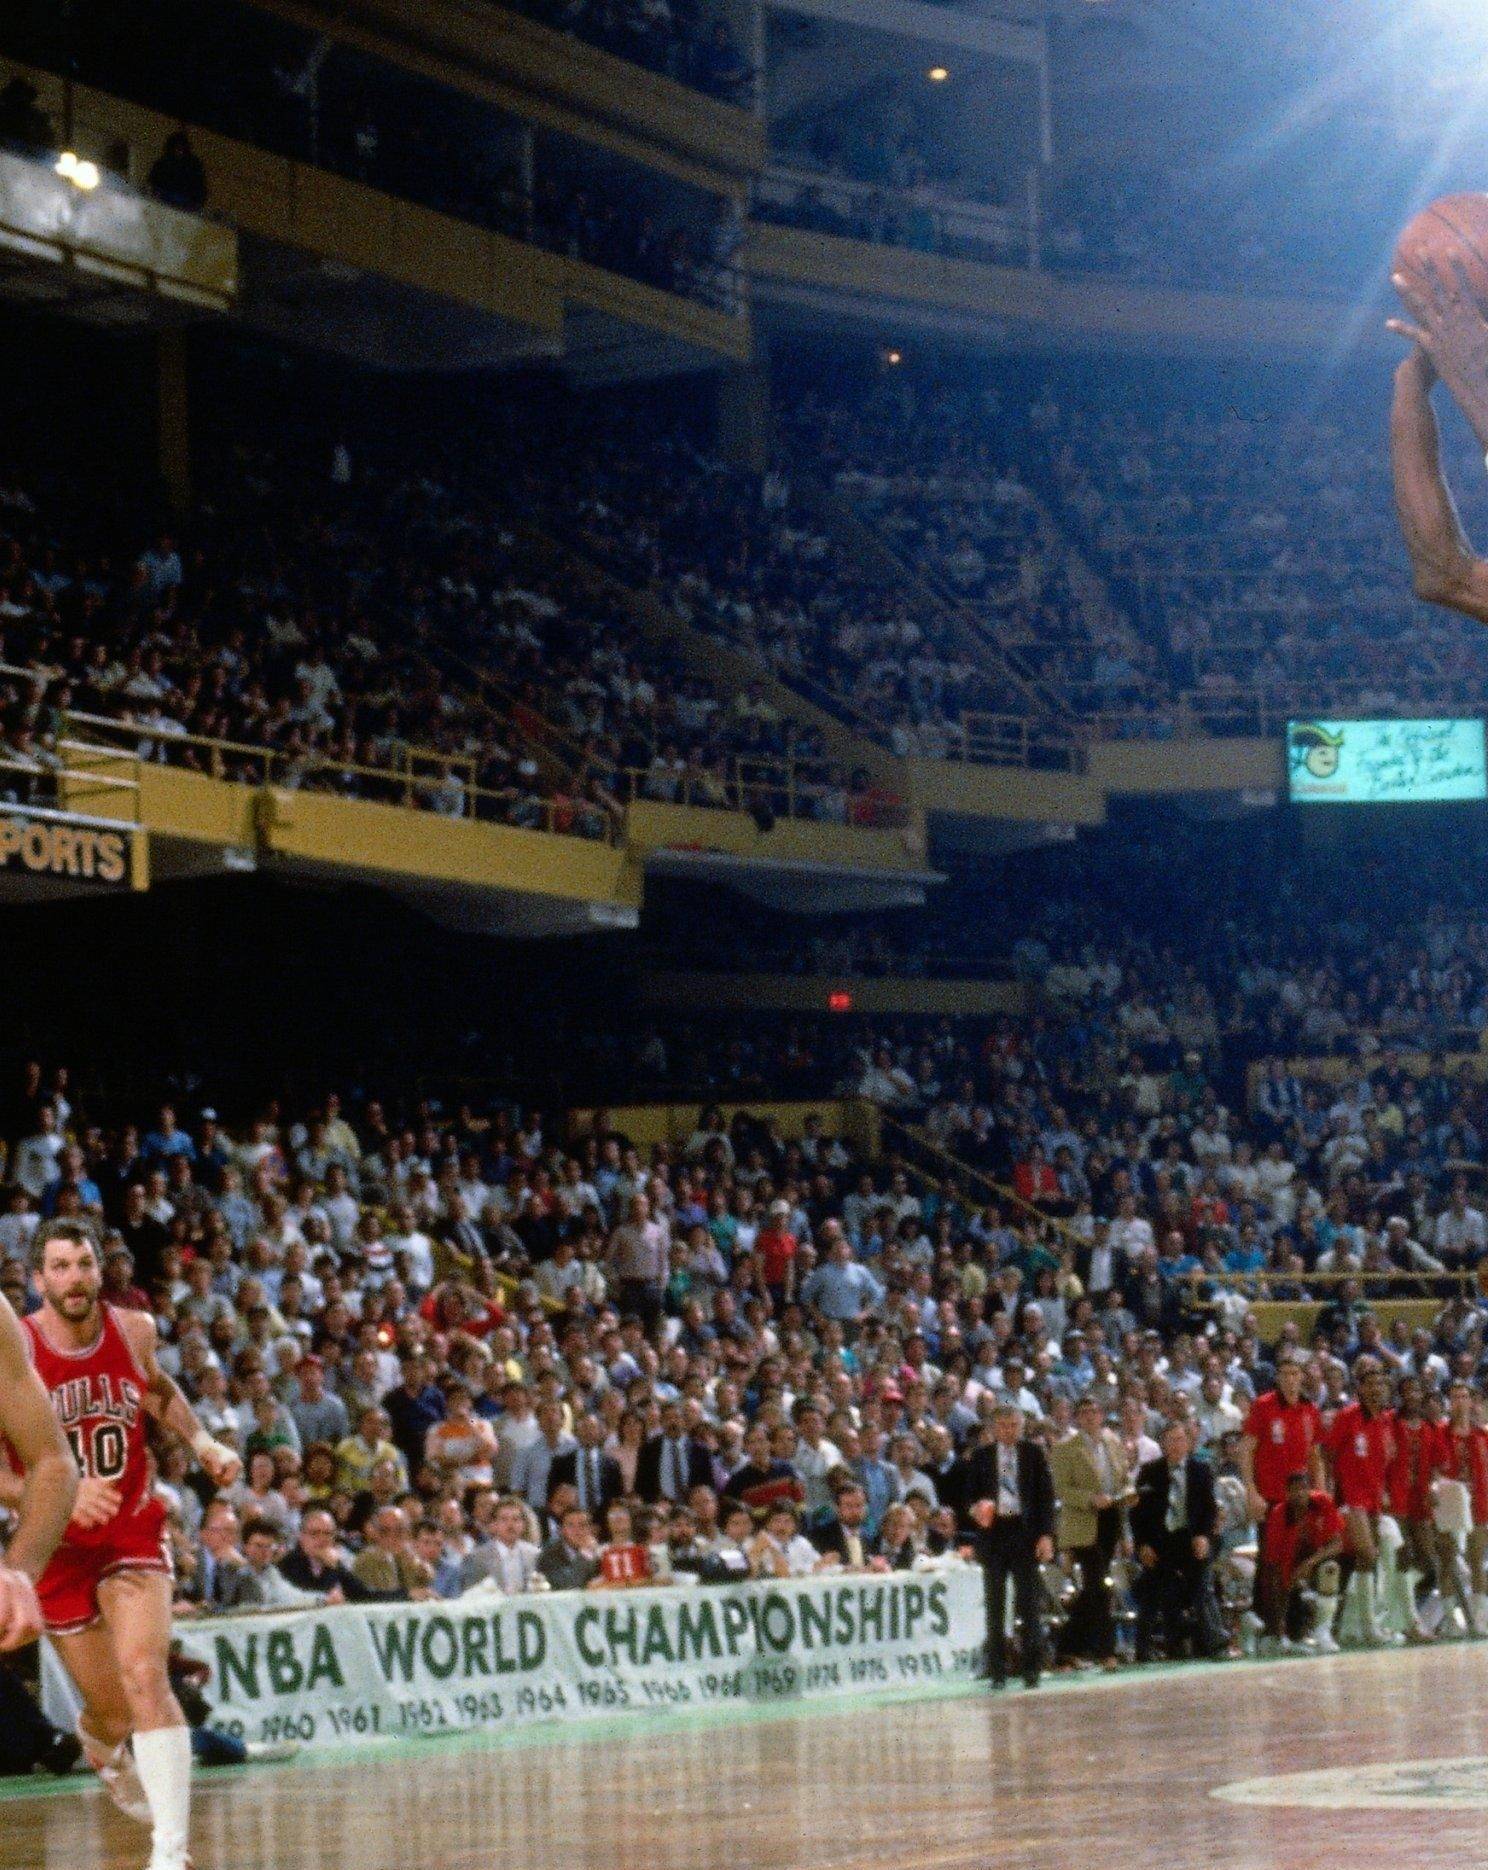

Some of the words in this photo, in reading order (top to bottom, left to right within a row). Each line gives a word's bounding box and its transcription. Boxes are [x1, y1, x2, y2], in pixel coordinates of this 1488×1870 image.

[214, 1622, 346, 1703] NBA
[366, 1610, 546, 1683] WORLD
[574, 1580, 949, 1669] CHAMPIONSHIPS
[326, 1703, 380, 1736] 1961
[516, 1684, 567, 1715] 1964
